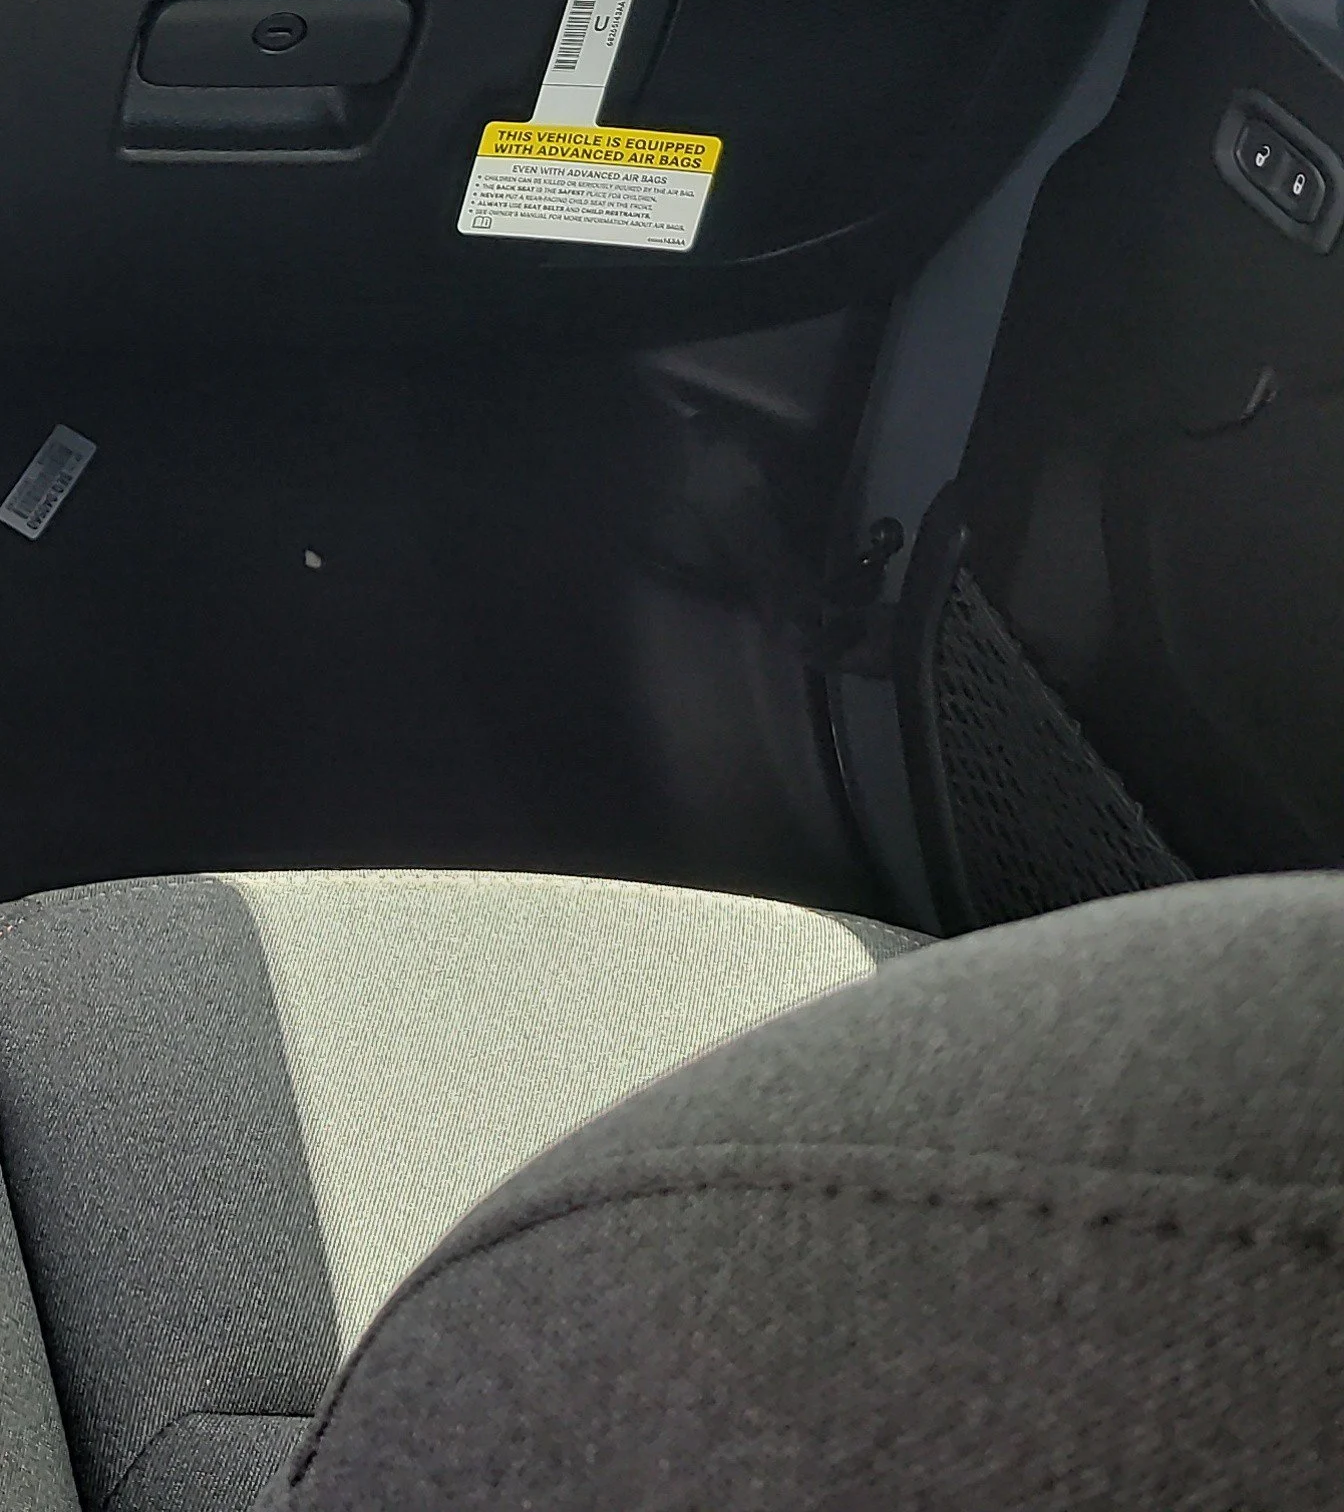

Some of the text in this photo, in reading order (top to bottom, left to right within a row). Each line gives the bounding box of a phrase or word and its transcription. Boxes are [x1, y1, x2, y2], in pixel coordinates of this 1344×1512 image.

[594, 15, 610, 32] U
[497, 130, 706, 156] THIS VEHICLE IS EQUIPPED
[494, 144, 702, 169] WITH ADVANCED AIR BAGS
[512, 164, 668, 185] EVEN WITH ADVANCED AIR BAGS
